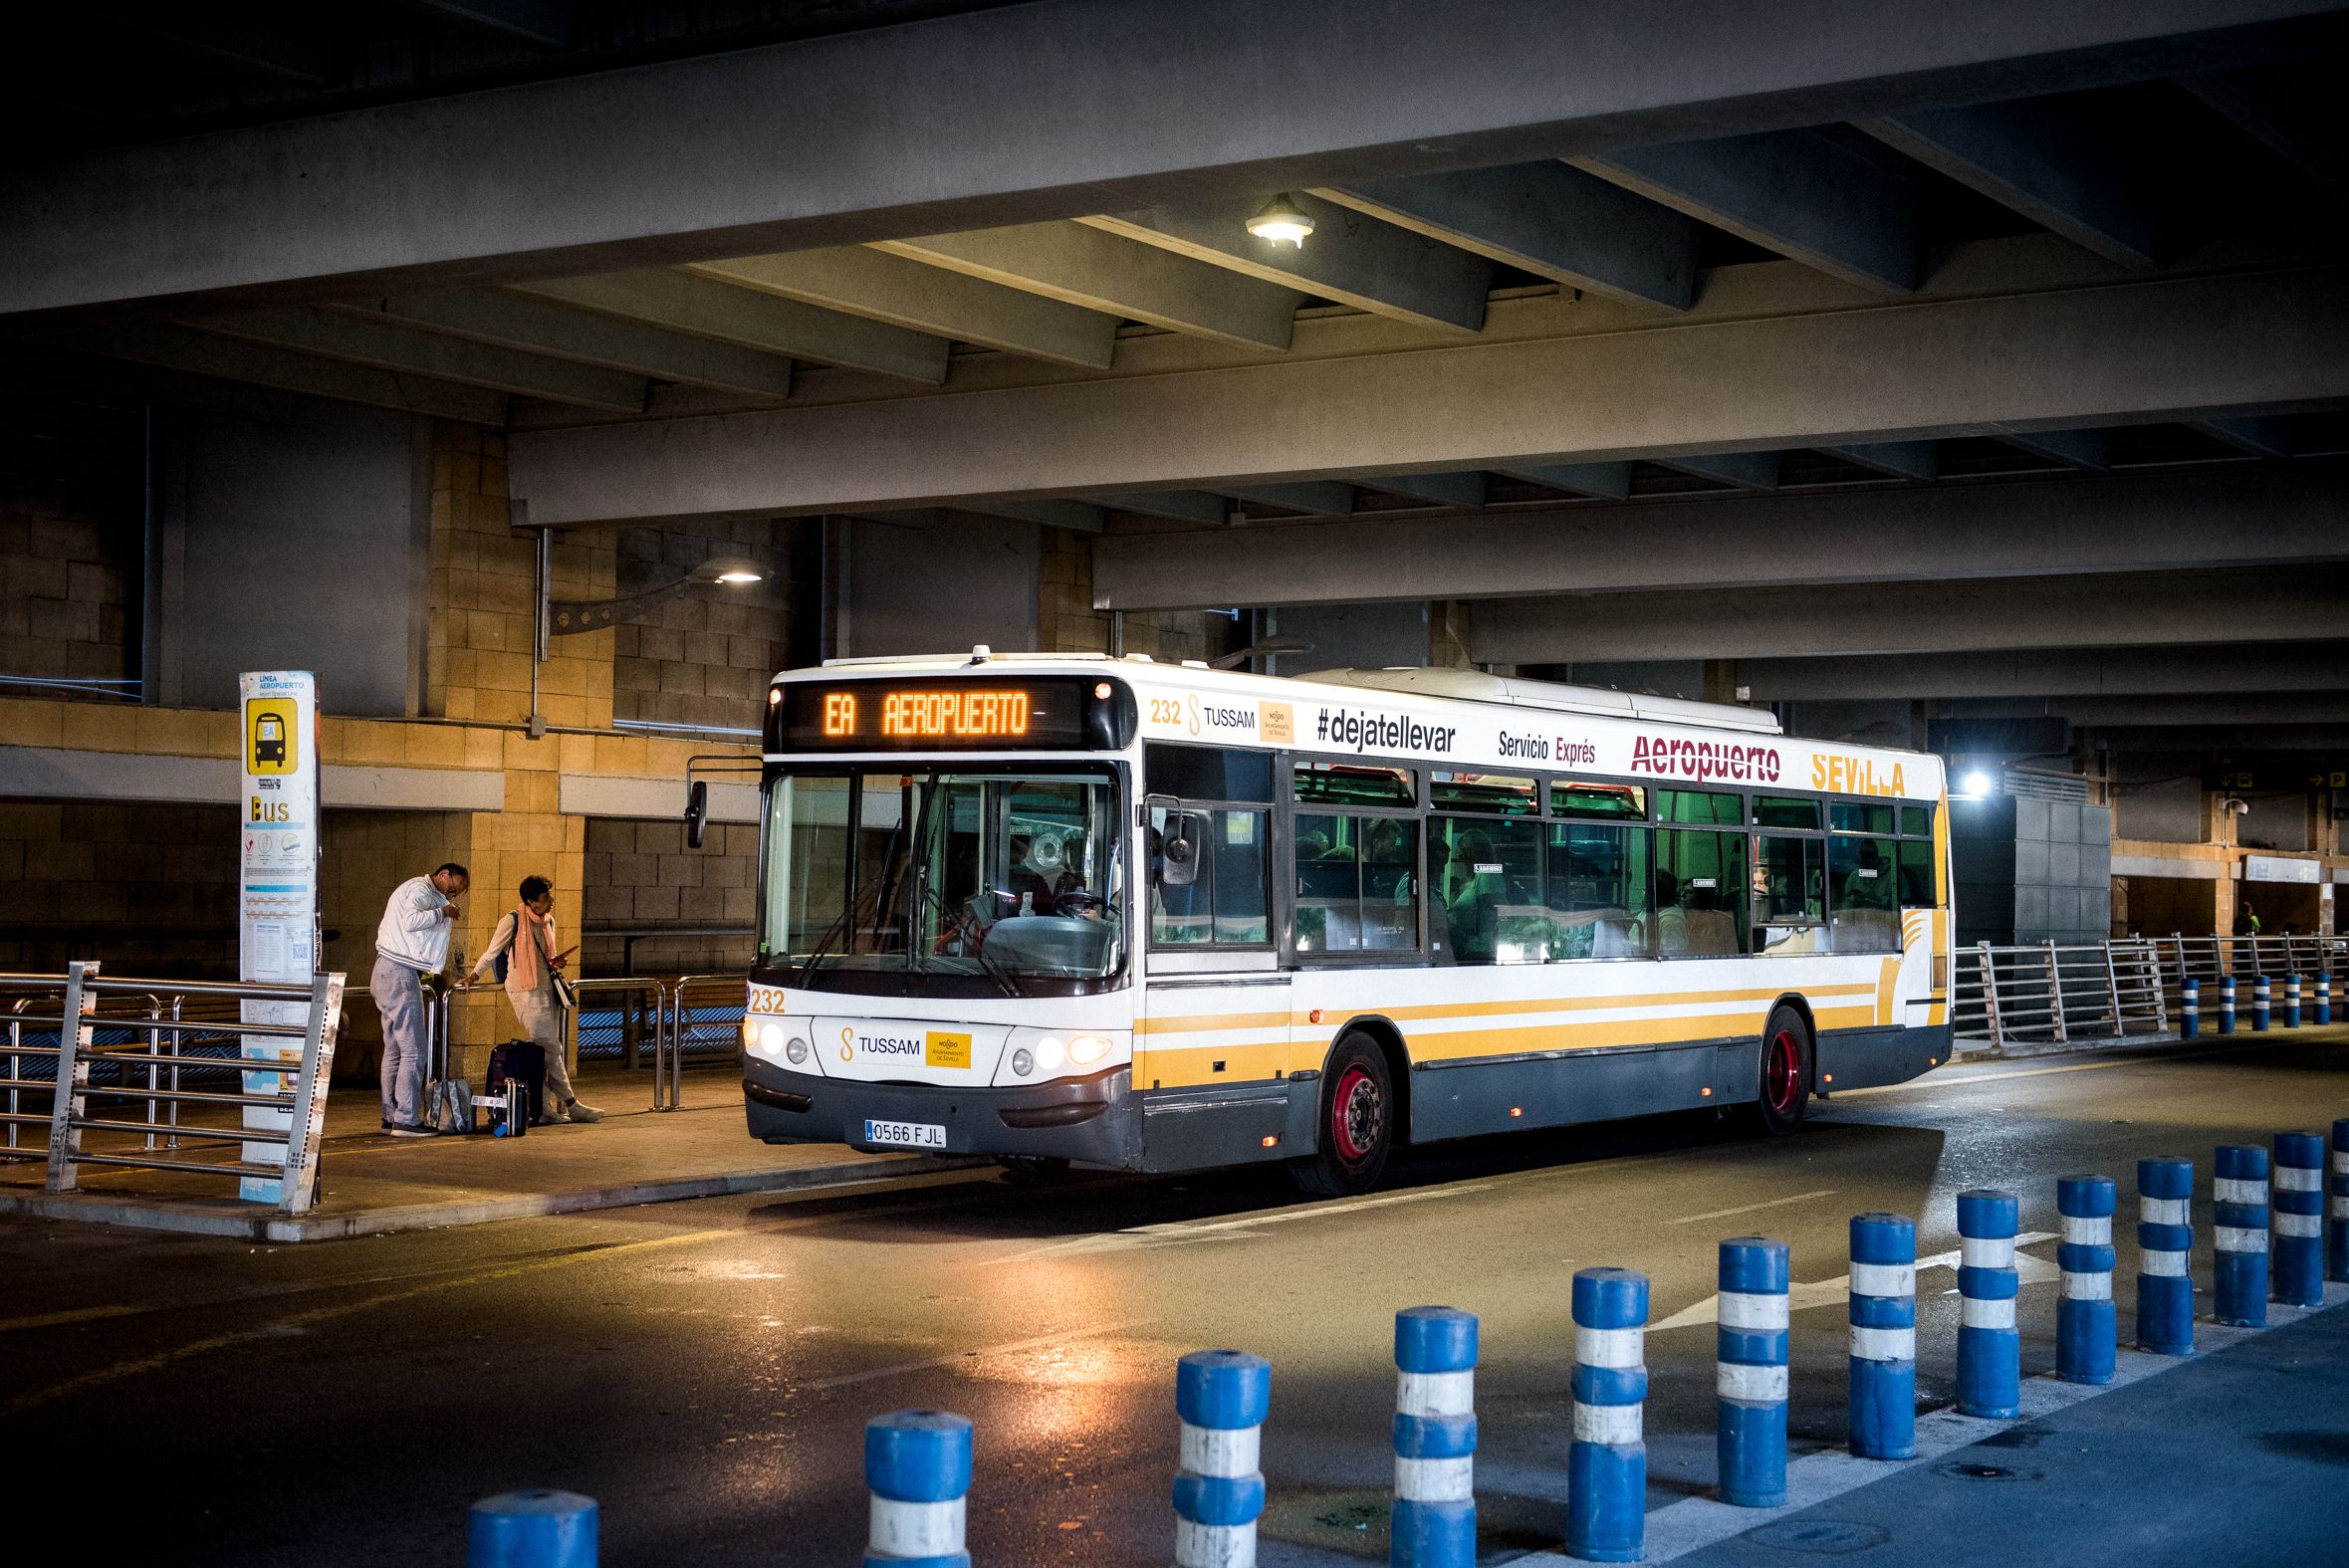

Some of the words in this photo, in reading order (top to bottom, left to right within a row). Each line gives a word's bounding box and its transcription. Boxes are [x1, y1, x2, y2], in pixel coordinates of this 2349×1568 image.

[825, 694, 855, 735] EA
[884, 693, 1028, 735] AEROPUERTO
[1150, 699, 1181, 725] 232
[1204, 707, 1255, 729] TUSSAM
[263, 726, 274, 737] EA
[1317, 708, 1456, 754] #dejatellevar
[1499, 730, 1548, 760] Servicio
[1555, 737, 1595, 768] Exprés
[1630, 736, 1780, 786] Aeropuerto
[1811, 754, 1905, 797] SEVILLA
[252, 795, 289, 822] Bus
[752, 989, 785, 1013] 232
[859, 1037, 920, 1055] TUSSAM
[932, 1048, 964, 1057] AYUNTAMIENTO
[874, 1124, 910, 1142] 0566
[915, 1127, 942, 1144] FJL
